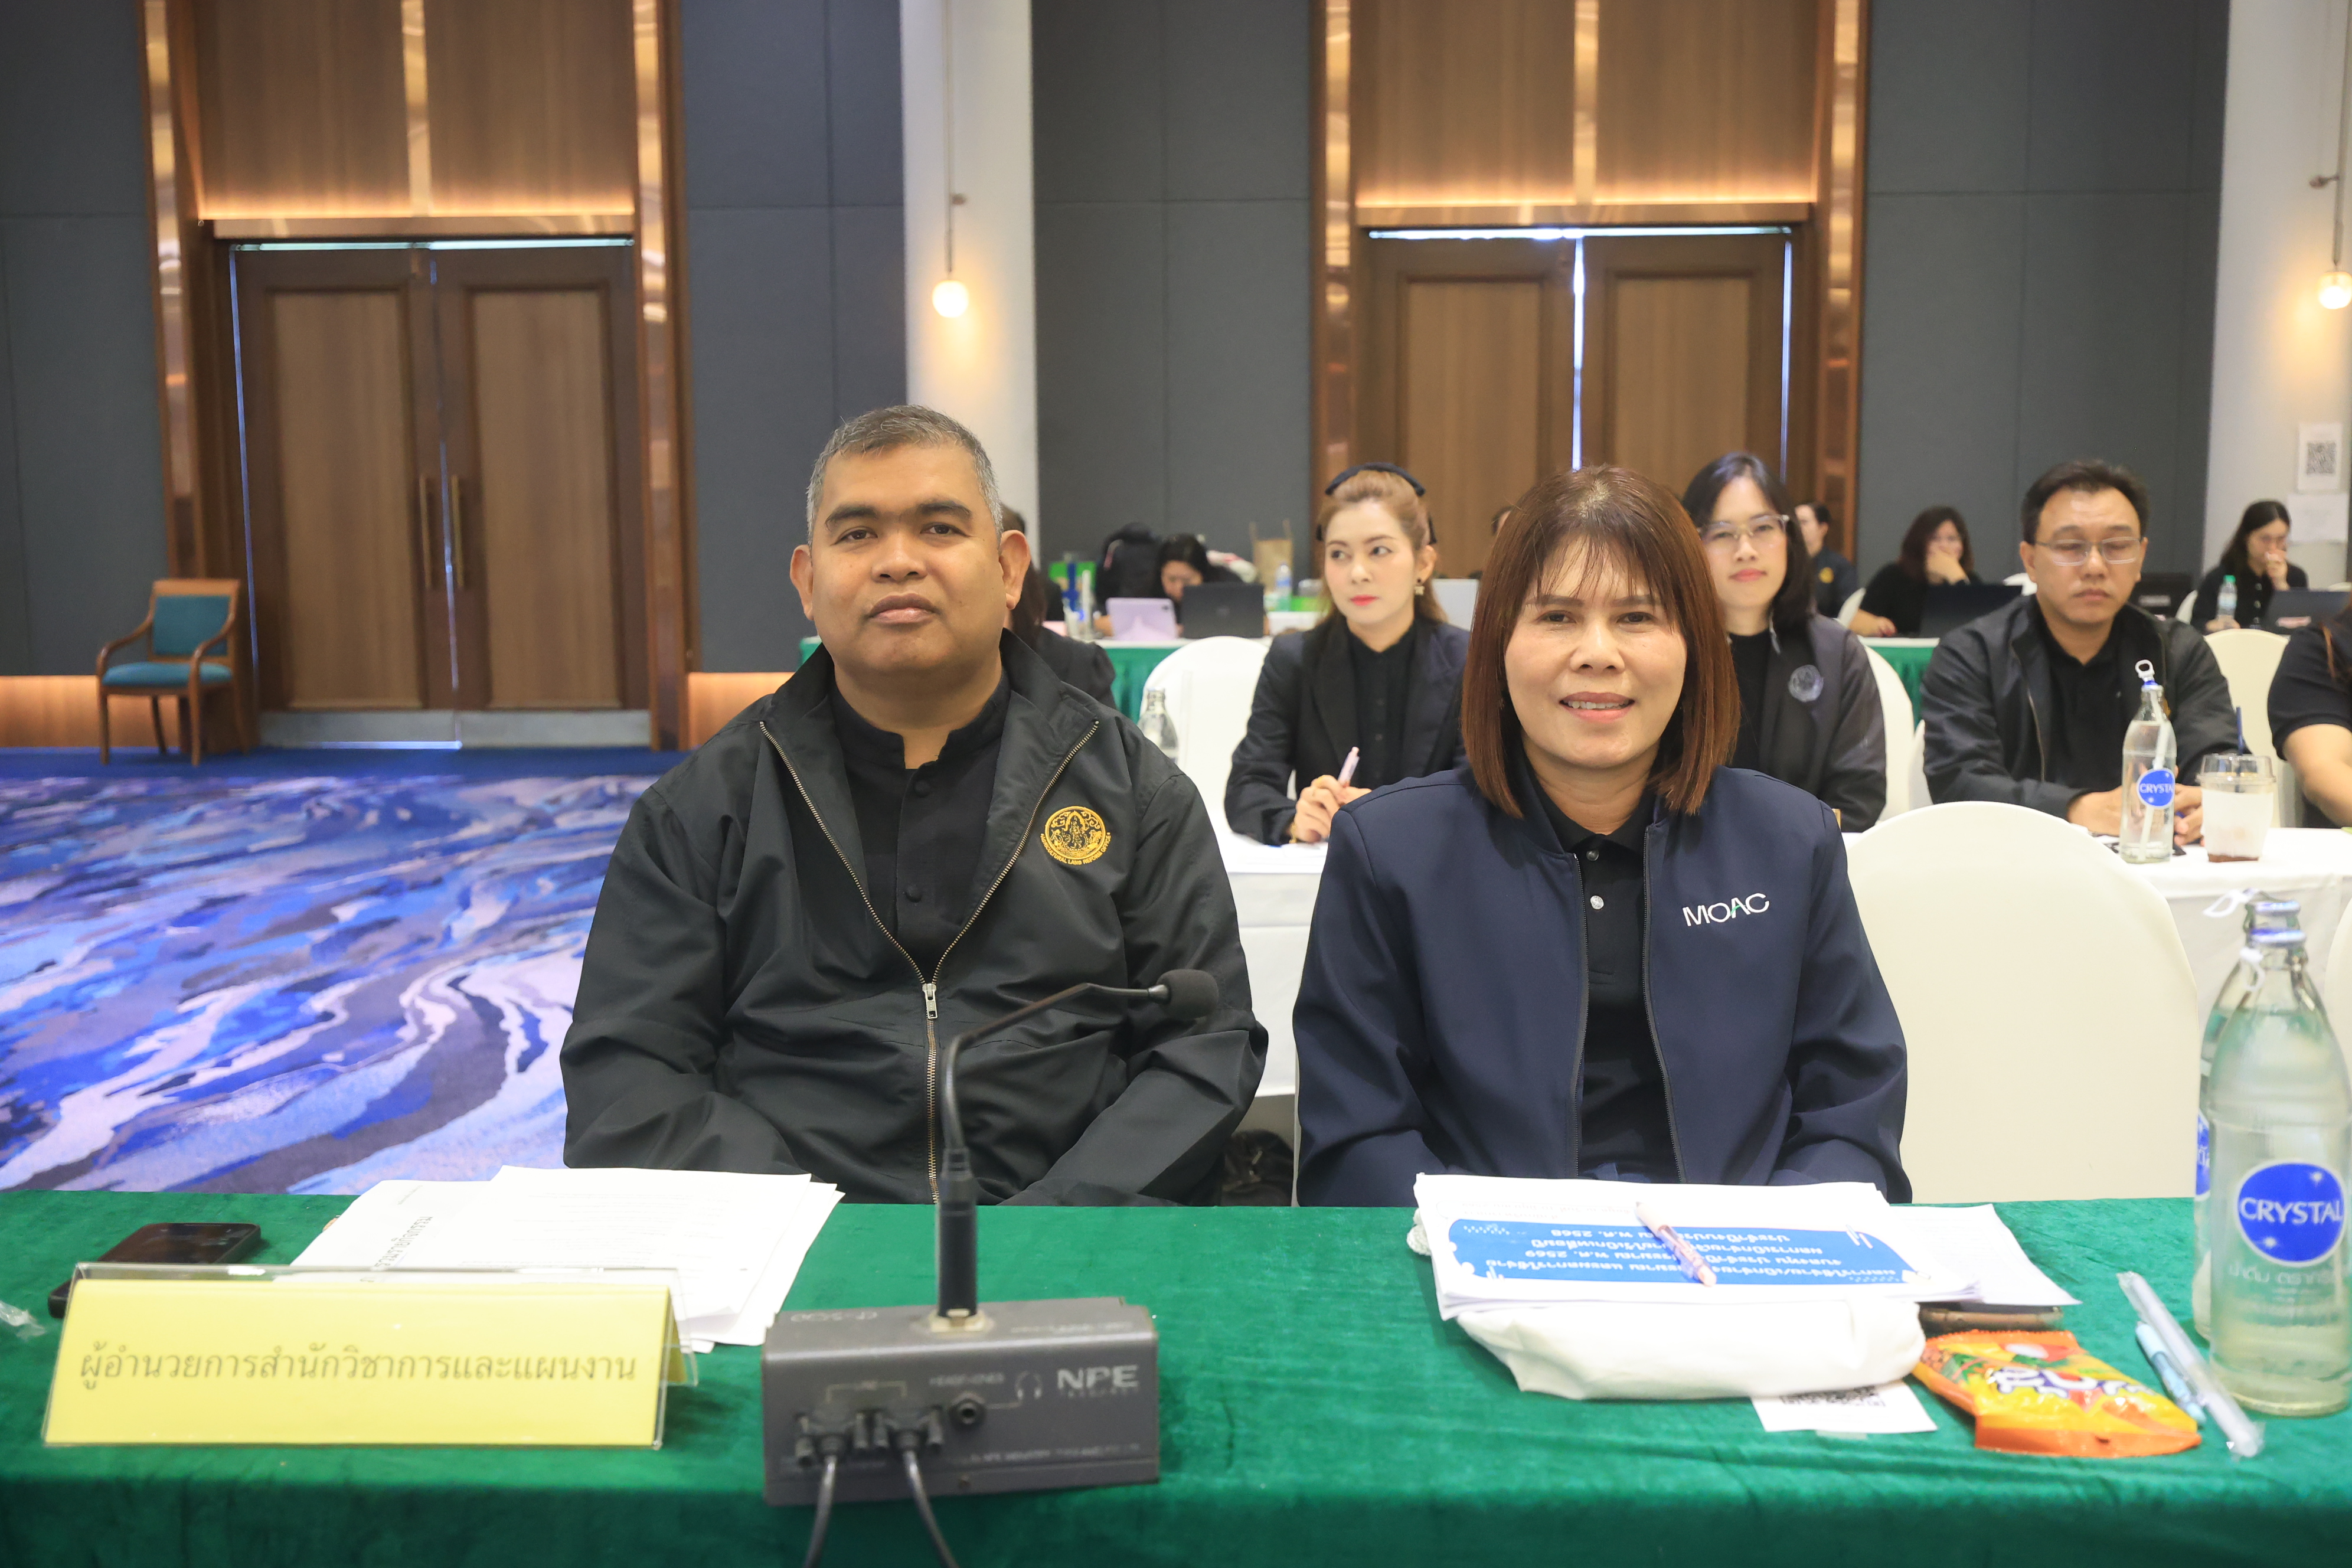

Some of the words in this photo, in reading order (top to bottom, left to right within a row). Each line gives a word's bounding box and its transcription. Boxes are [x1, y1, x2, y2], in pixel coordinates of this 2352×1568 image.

[2140, 783, 2174, 794] CRYSTA
[1040, 835, 1067, 864] AGRICULTURAL
[1083, 851, 1103, 864] REFORM
[1102, 834, 1111, 852] OFFICE
[1683, 893, 1770, 926] MOAC
[2239, 1196, 2344, 1224] CRYSTAL
[1551, 1229, 1592, 1237] 2568
[1525, 1250, 1567, 1258] 2569
[81, 1341, 636, 1390] ผู้อำนวยการสำนักวิชาการและแผนงาน
[1057, 1364, 1139, 1389] NPE
